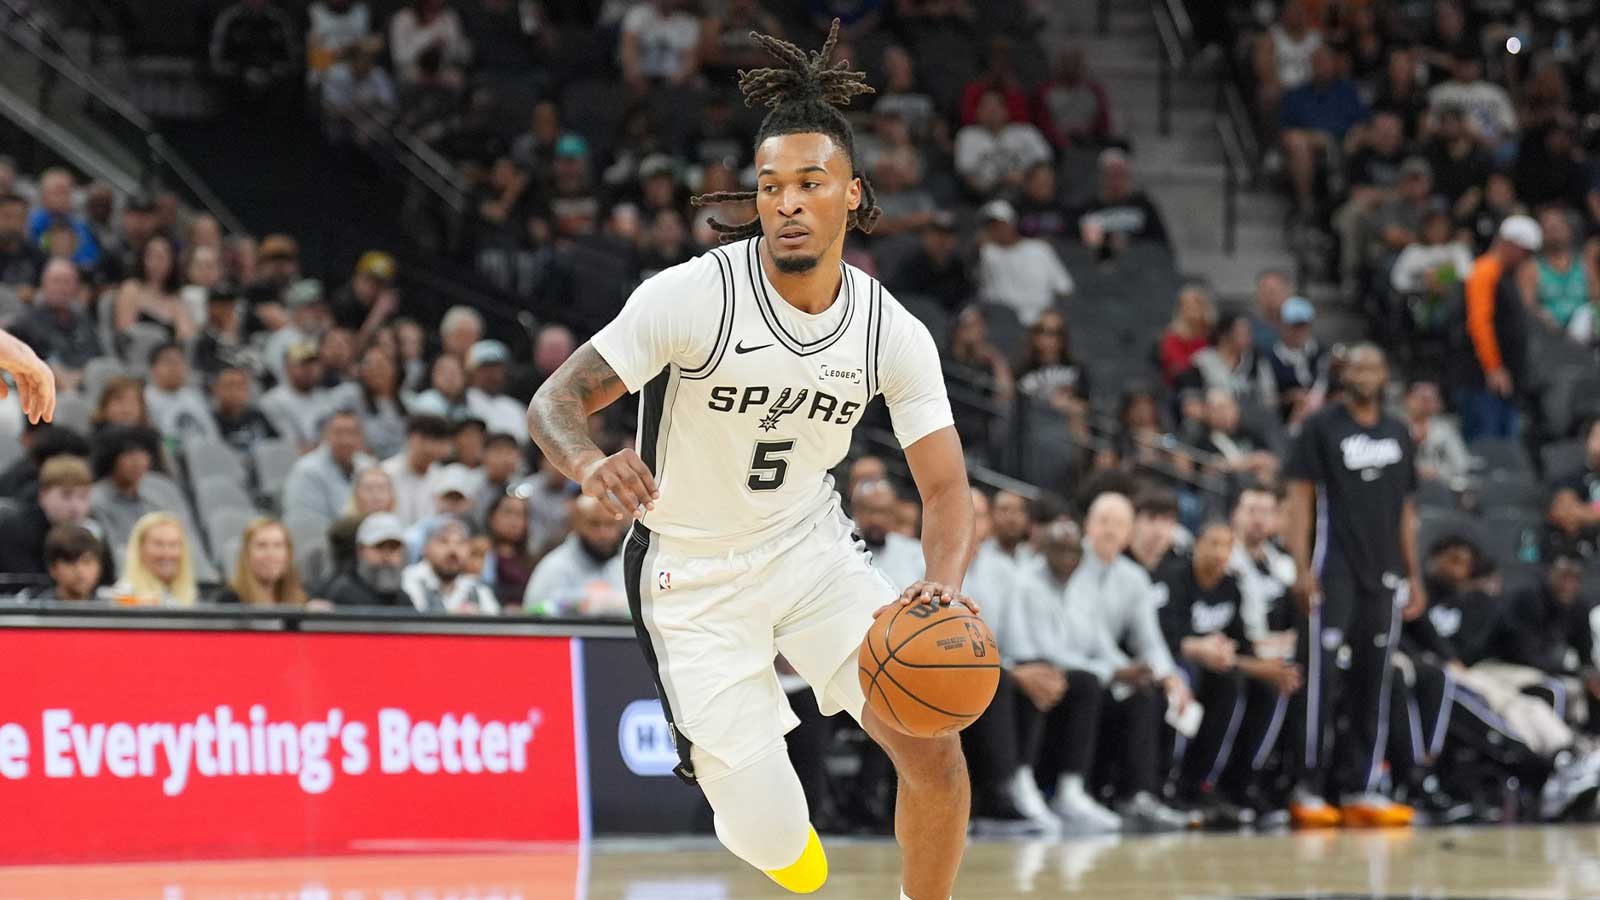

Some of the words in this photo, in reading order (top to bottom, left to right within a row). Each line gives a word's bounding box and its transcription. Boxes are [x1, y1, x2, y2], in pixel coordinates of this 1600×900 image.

[823, 367, 858, 381] LEDGER
[708, 385, 861, 430] SPURS
[746, 439, 796, 492] 5
[42, 704, 370, 796] Everything's
[377, 707, 533, 774] Better
